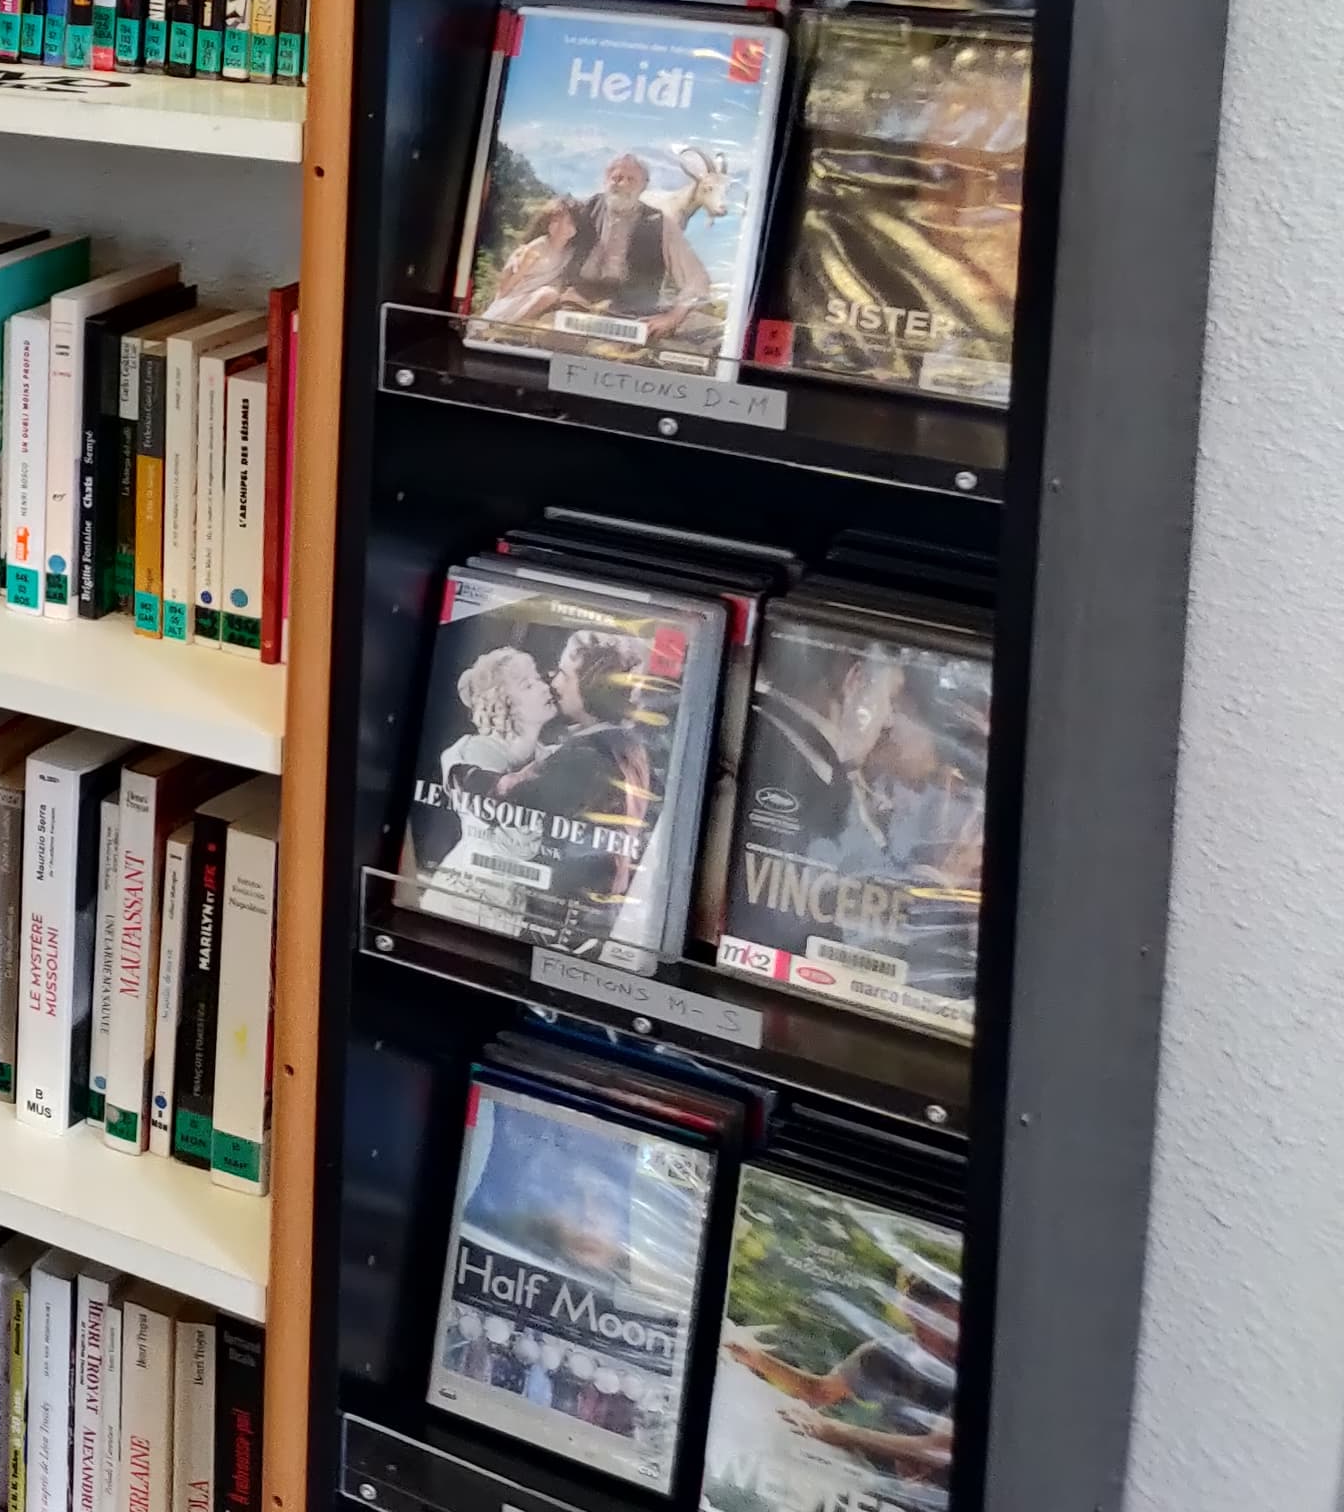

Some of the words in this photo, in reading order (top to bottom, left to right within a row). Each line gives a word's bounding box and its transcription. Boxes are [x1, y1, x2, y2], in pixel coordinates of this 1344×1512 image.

[567, 57, 694, 110] Heidi
[826, 297, 955, 341] SISTER
[566, 363, 688, 401] FICTIONS
[413, 779, 441, 806] LE
[448, 790, 545, 841] MASQUE
[550, 817, 588, 843] DE
[590, 824, 639, 861] FER
[37, 834, 48, 881] Maurizio
[745, 854, 910, 925] VINCERE
[30, 912, 43, 988] MYSTÈRE
[119, 850, 146, 999] MAUPASSANT
[198, 905, 215, 971] MARILYN
[46, 926, 59, 1017] MUSSOLINI
[541, 958, 648, 1001] FICTIONS
[721, 941, 773, 975] mk2
[30, 993, 41, 1012] LE
[26, 1099, 53, 1119] MUS
[87, 1298, 104, 1349] HENRI
[457, 1252, 545, 1304] Half
[549, 1285, 672, 1356] Moon
[84, 1354, 99, 1414] TROYAT
